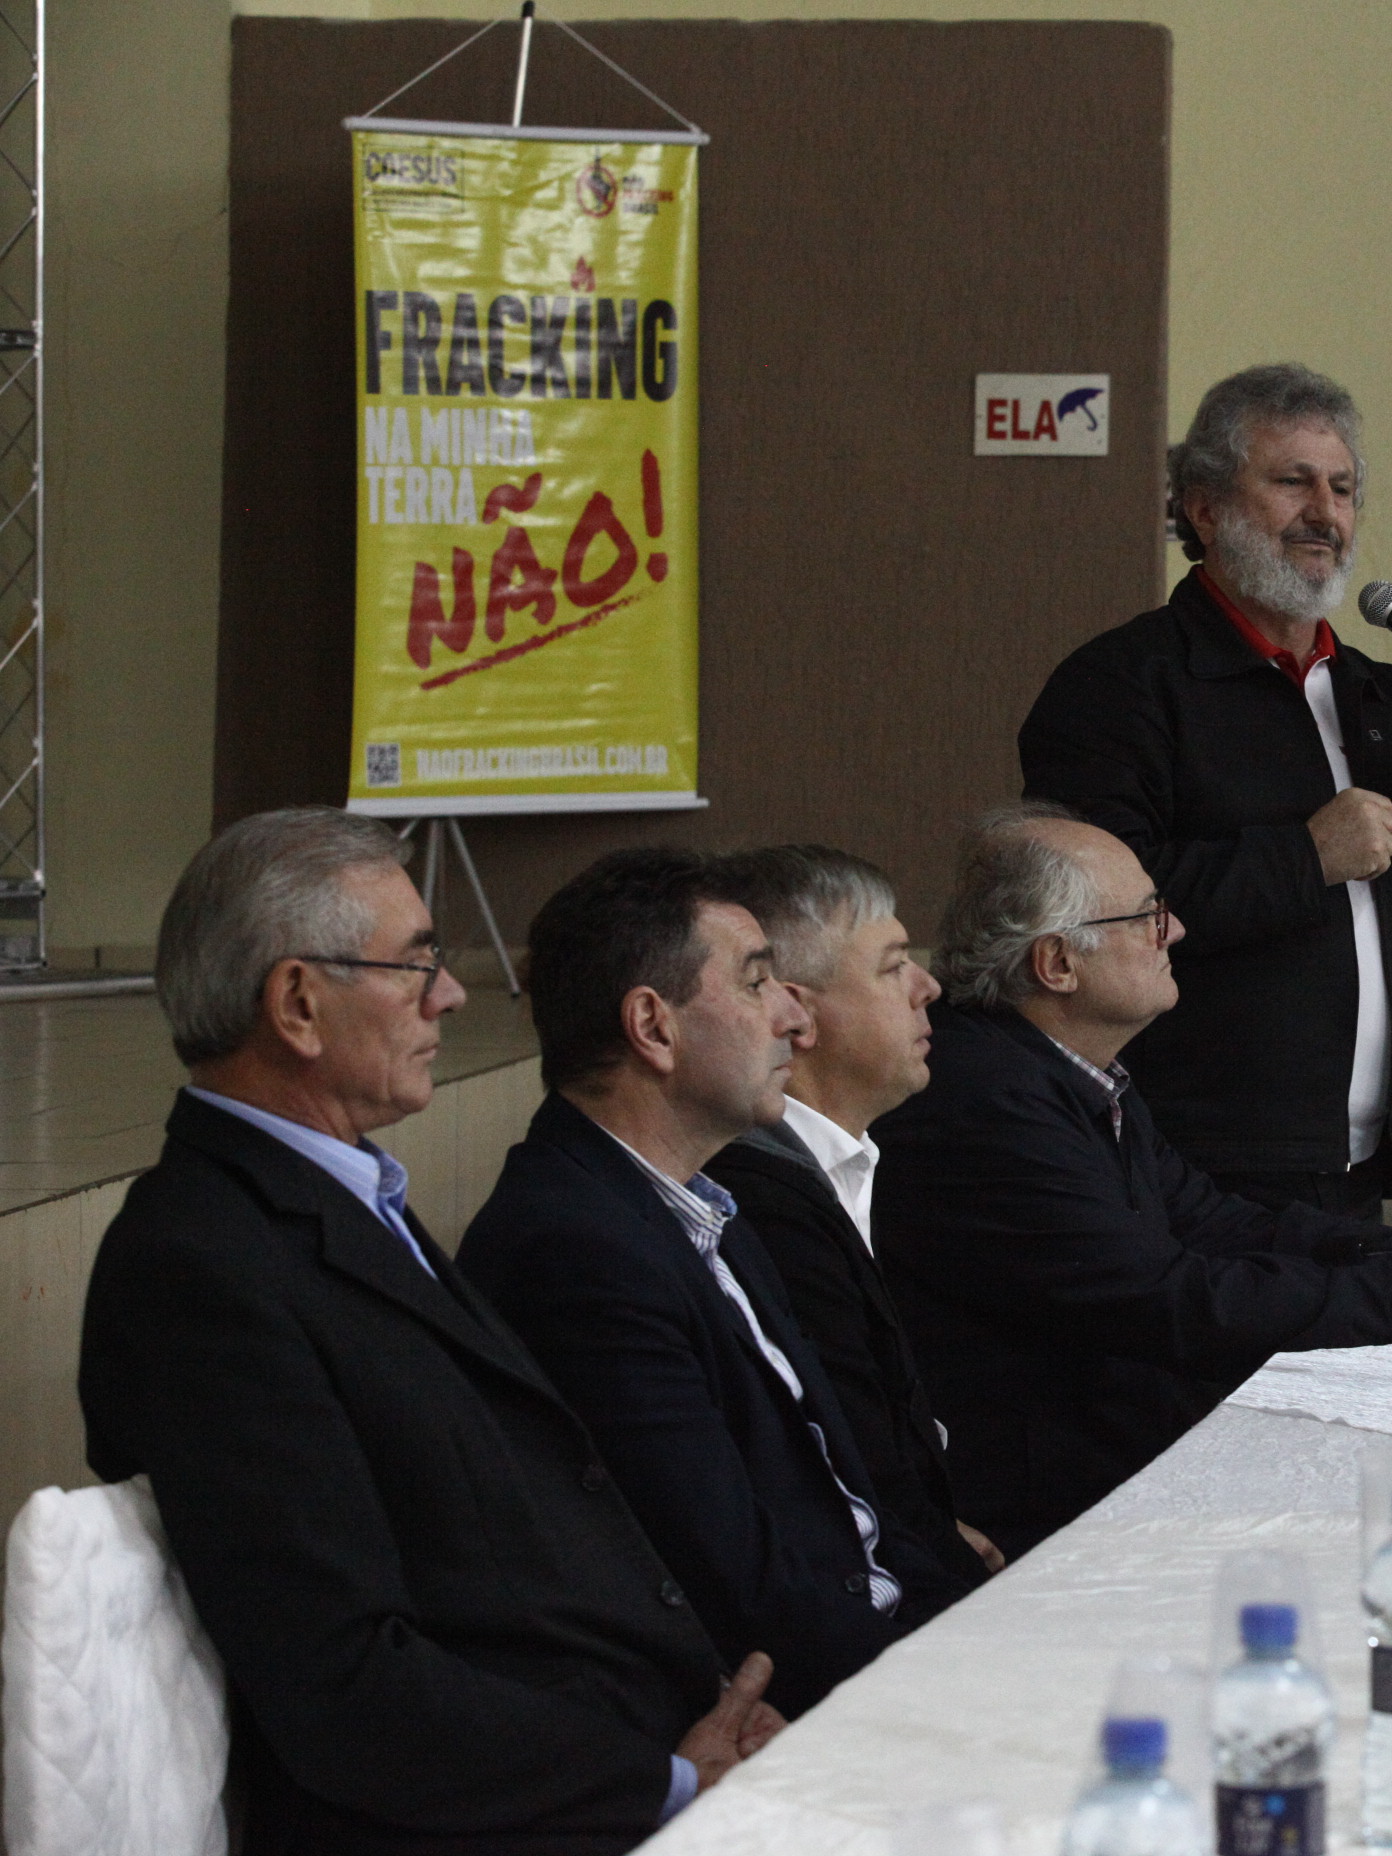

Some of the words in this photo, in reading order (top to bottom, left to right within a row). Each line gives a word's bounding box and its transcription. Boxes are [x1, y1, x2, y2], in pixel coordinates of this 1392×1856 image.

[365, 290, 678, 402] FRACKING
[365, 406, 414, 465] NA
[420, 407, 536, 467] MINHA
[986, 398, 1058, 442] ELA
[364, 466, 478, 525] TERRA
[406, 448, 669, 670] NÃO!
